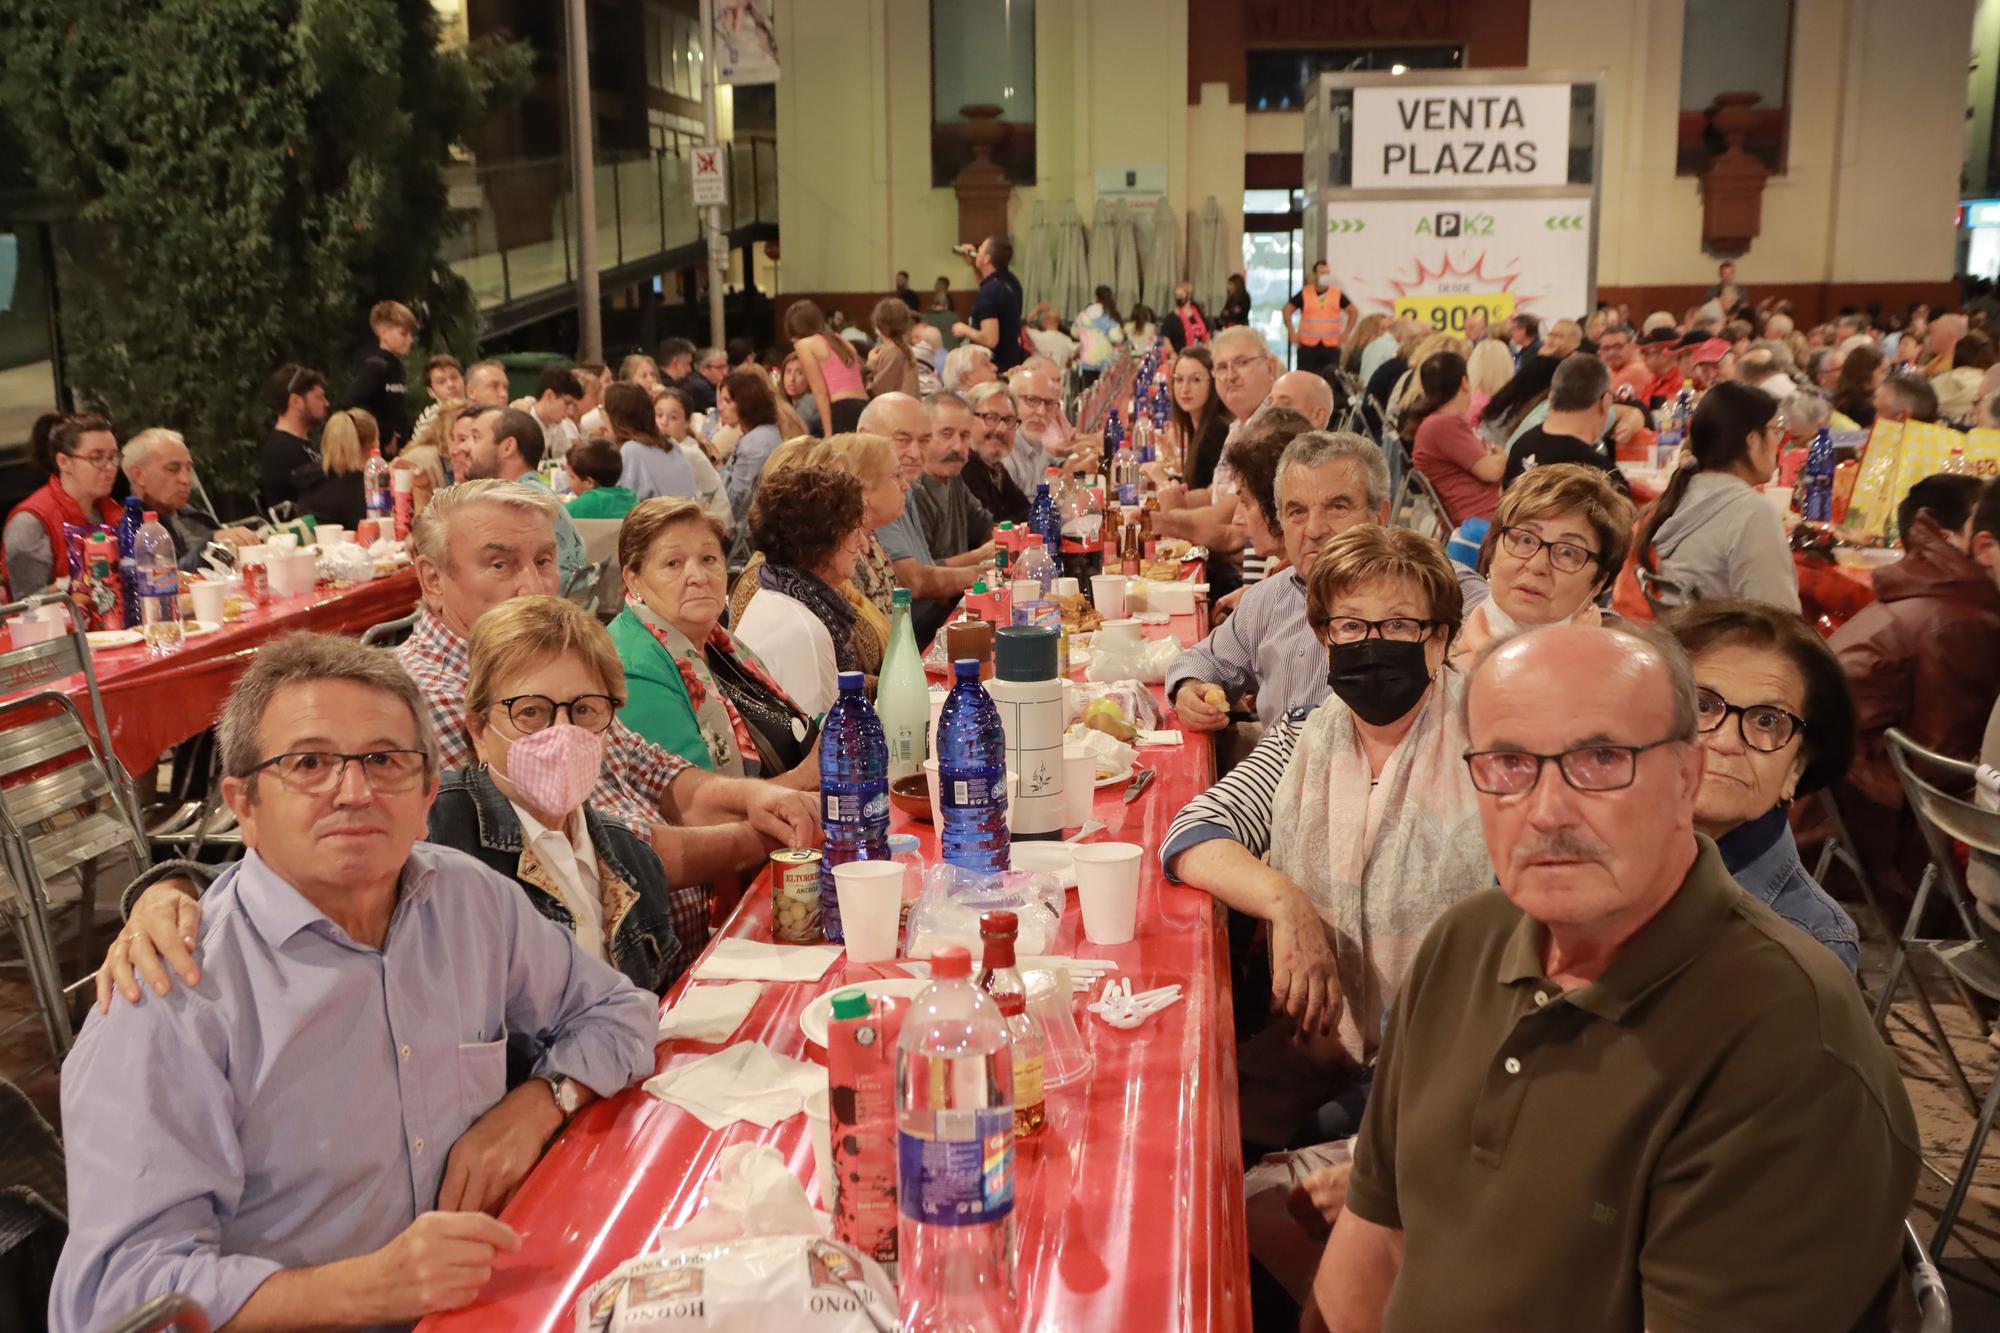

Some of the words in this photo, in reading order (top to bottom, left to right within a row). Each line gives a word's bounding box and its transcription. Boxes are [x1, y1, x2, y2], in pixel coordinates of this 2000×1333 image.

[1397, 97, 1526, 131] VENTA
[1383, 141, 1537, 176] PLAZAS
[1438, 283, 1471, 293] DESDE
